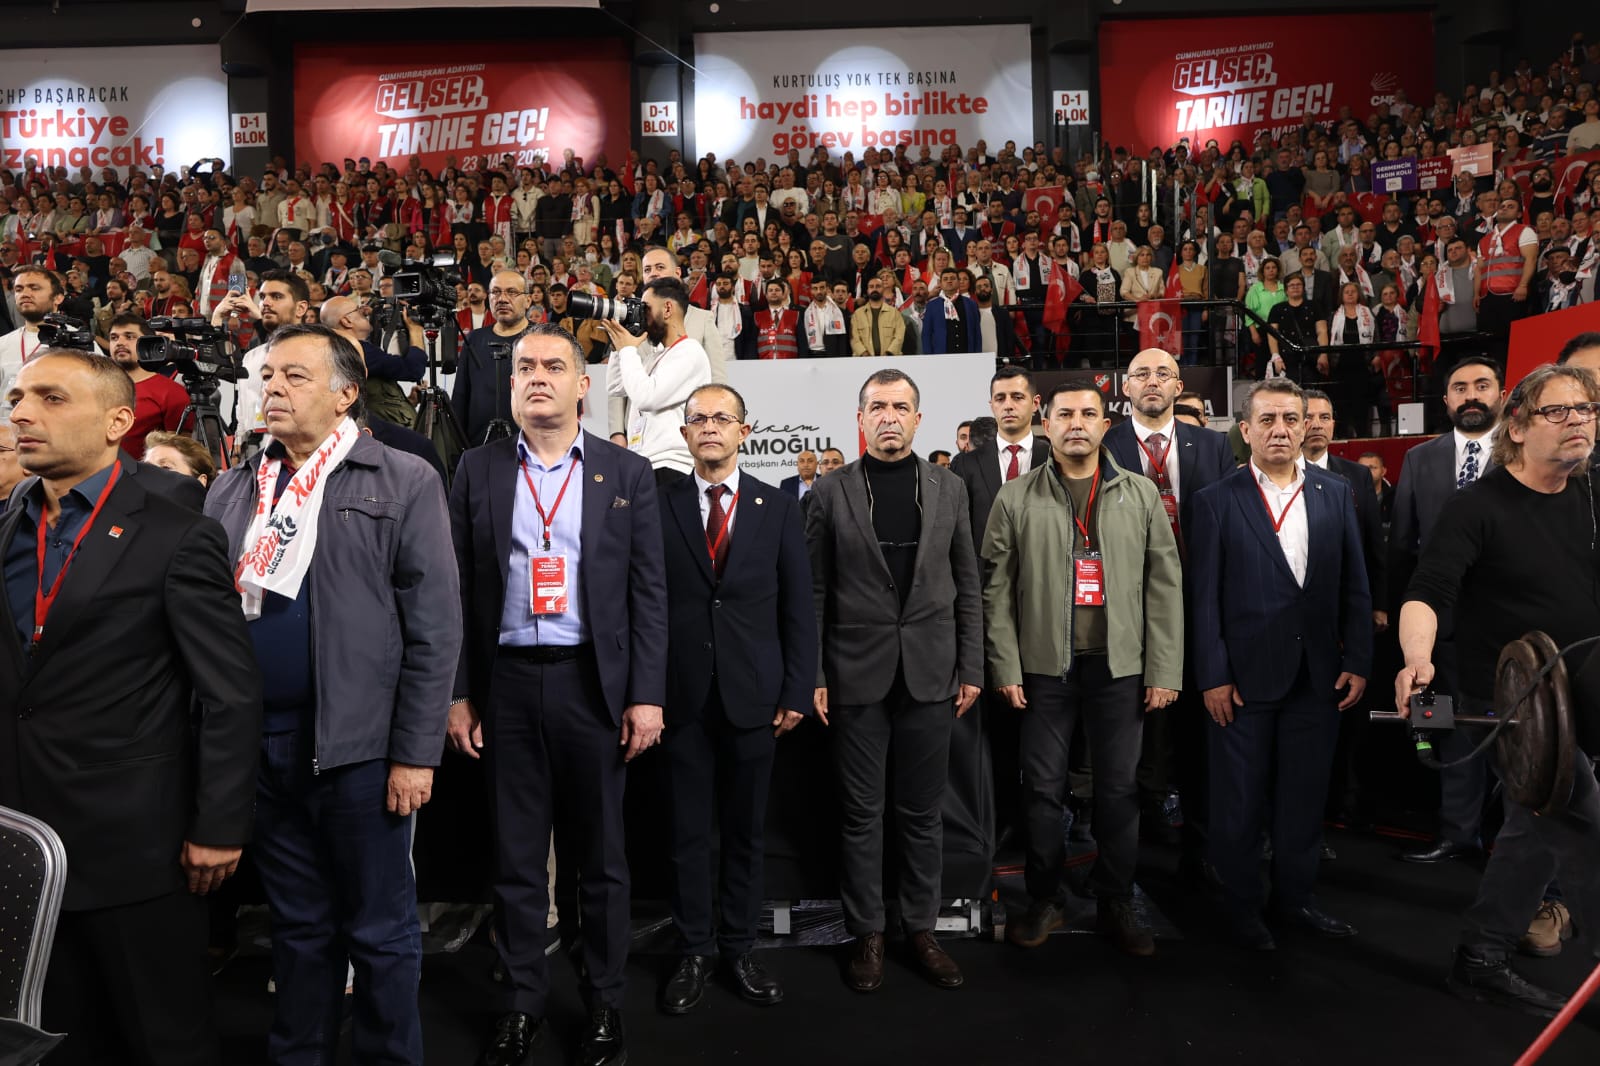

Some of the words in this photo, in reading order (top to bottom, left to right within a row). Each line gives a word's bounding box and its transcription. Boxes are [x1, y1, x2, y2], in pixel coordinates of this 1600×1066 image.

[773, 73, 840, 88] KURTULUŞ
[847, 73, 871, 86] YOK
[878, 72, 901, 85] TEK
[908, 71, 957, 86] BAŞINA
[35, 86, 129, 105] BAŞARACAK
[1062, 93, 1081, 106] D-1
[650, 104, 668, 117] D-1
[740, 94, 818, 125] haydi
[826, 94, 877, 122] hep
[885, 91, 988, 116] birlikte
[1055, 109, 1087, 121] BLOK
[0, 108, 129, 145] Türkiye
[240, 115, 259, 128] D-1
[481, 107, 549, 146] GEÇ!
[643, 120, 675, 133] BLOK
[235, 131, 266, 144] BLOK
[772, 125, 854, 155] görev
[0, 138, 165, 168] zanacak!
[748, 419, 820, 434] krem
[738, 434, 831, 456] AMOĞLU
